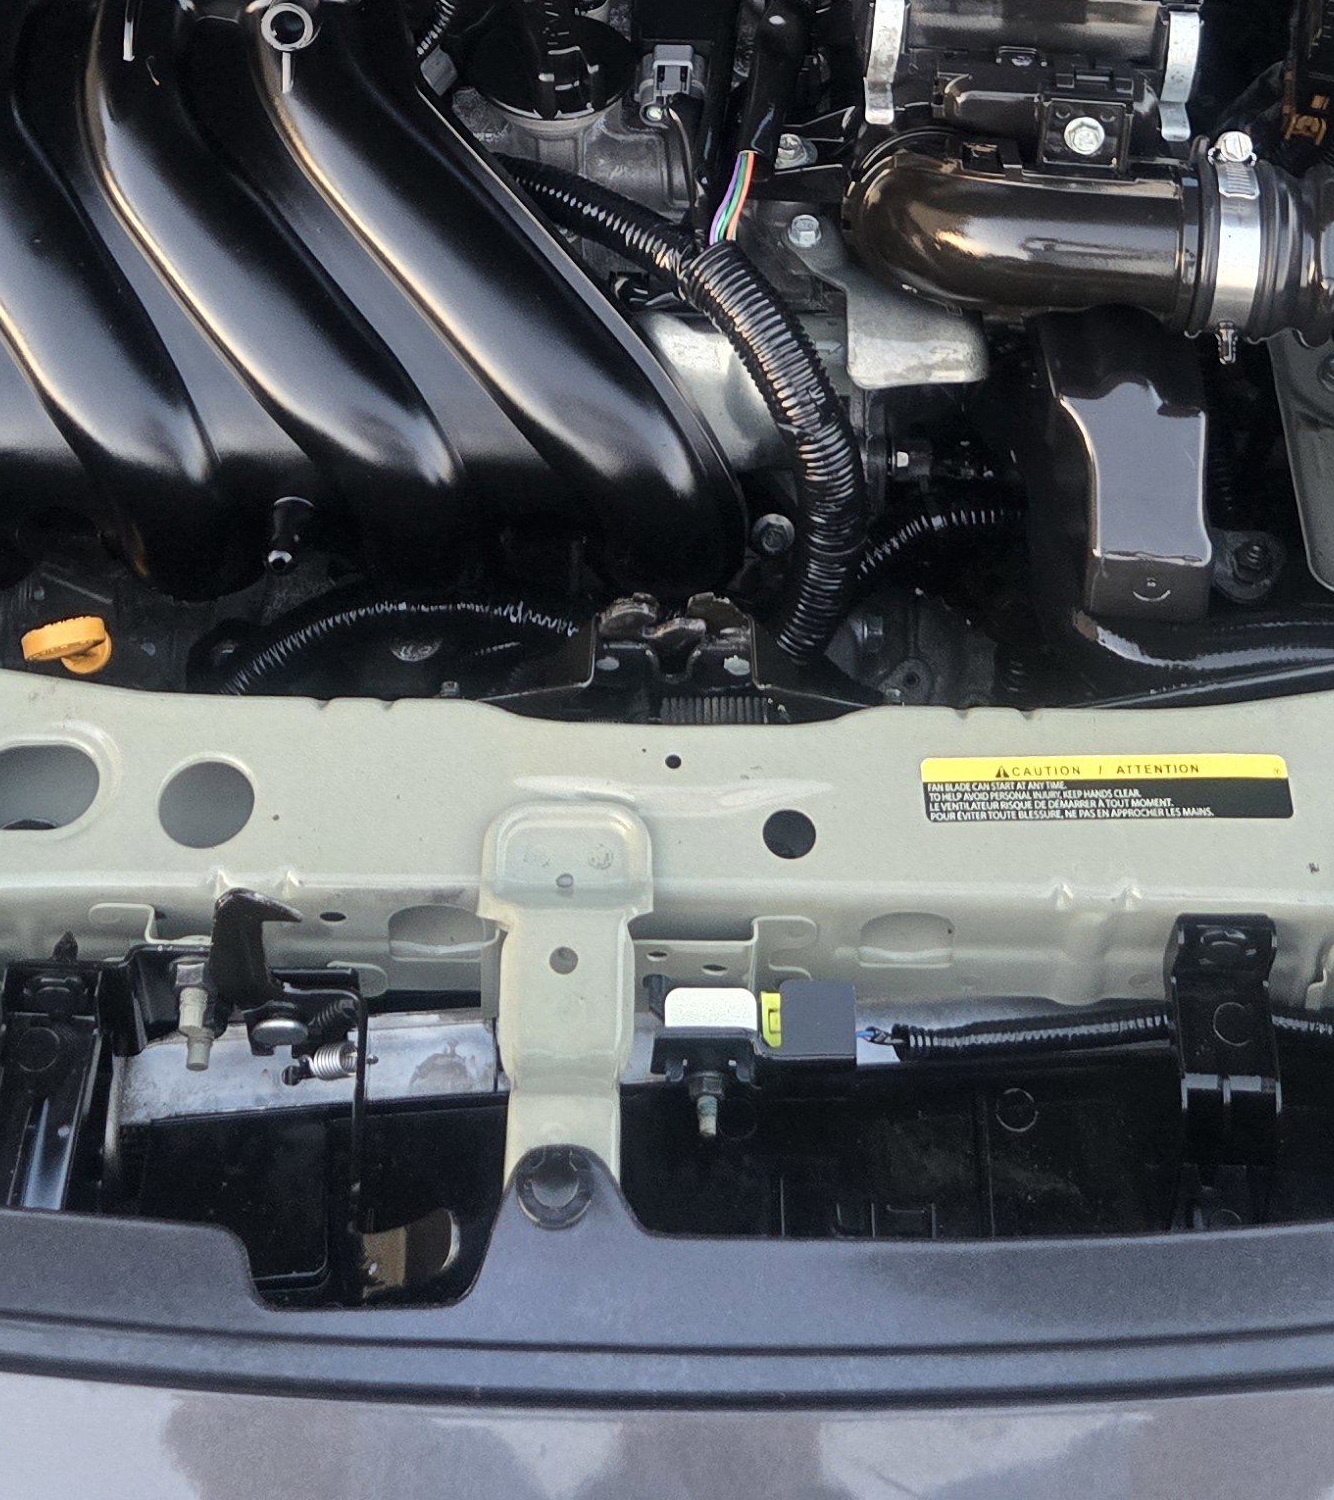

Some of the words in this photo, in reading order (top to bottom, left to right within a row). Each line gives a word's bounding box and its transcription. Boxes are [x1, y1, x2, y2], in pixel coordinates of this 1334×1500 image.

[1012, 765, 1081, 777] CAUTION
[1116, 763, 1199, 775] ATTENTION
[928, 782, 944, 791] FAN
[945, 782, 971, 791] BLADE
[972, 782, 990, 791] CAN
[991, 782, 1014, 791] START
[1015, 782, 1026, 790] AT
[1028, 781, 1045, 790] ANY
[929, 792, 940, 801] TO
[942, 792, 962, 800] HELP
[964, 792, 989, 800] AVOID
[990, 791, 1031, 800] PERSONAL
[1064, 791, 1082, 799] KEEP
[1083, 790, 1112, 799] HANDS
[930, 801, 939, 810] LE
[940, 801, 999, 810] VENTILATEUR
[1000, 800, 1032, 809] RISQUE
[1034, 800, 1046, 808] DE
[1047, 800, 1096, 808] DÉMARRER
[1106, 799, 1129, 808] TOUT
[930, 811, 955, 820] POUR
[957, 811, 987, 819] ÉVITER
[988, 810, 1016, 819] TOUTE
[1065, 810, 1077, 818] NE
[1078, 809, 1096, 818] PAS
[1097, 809, 1109, 818] EN
[1111, 809, 1165, 818] APPROCHER
[1166, 808, 1180, 817] LES
